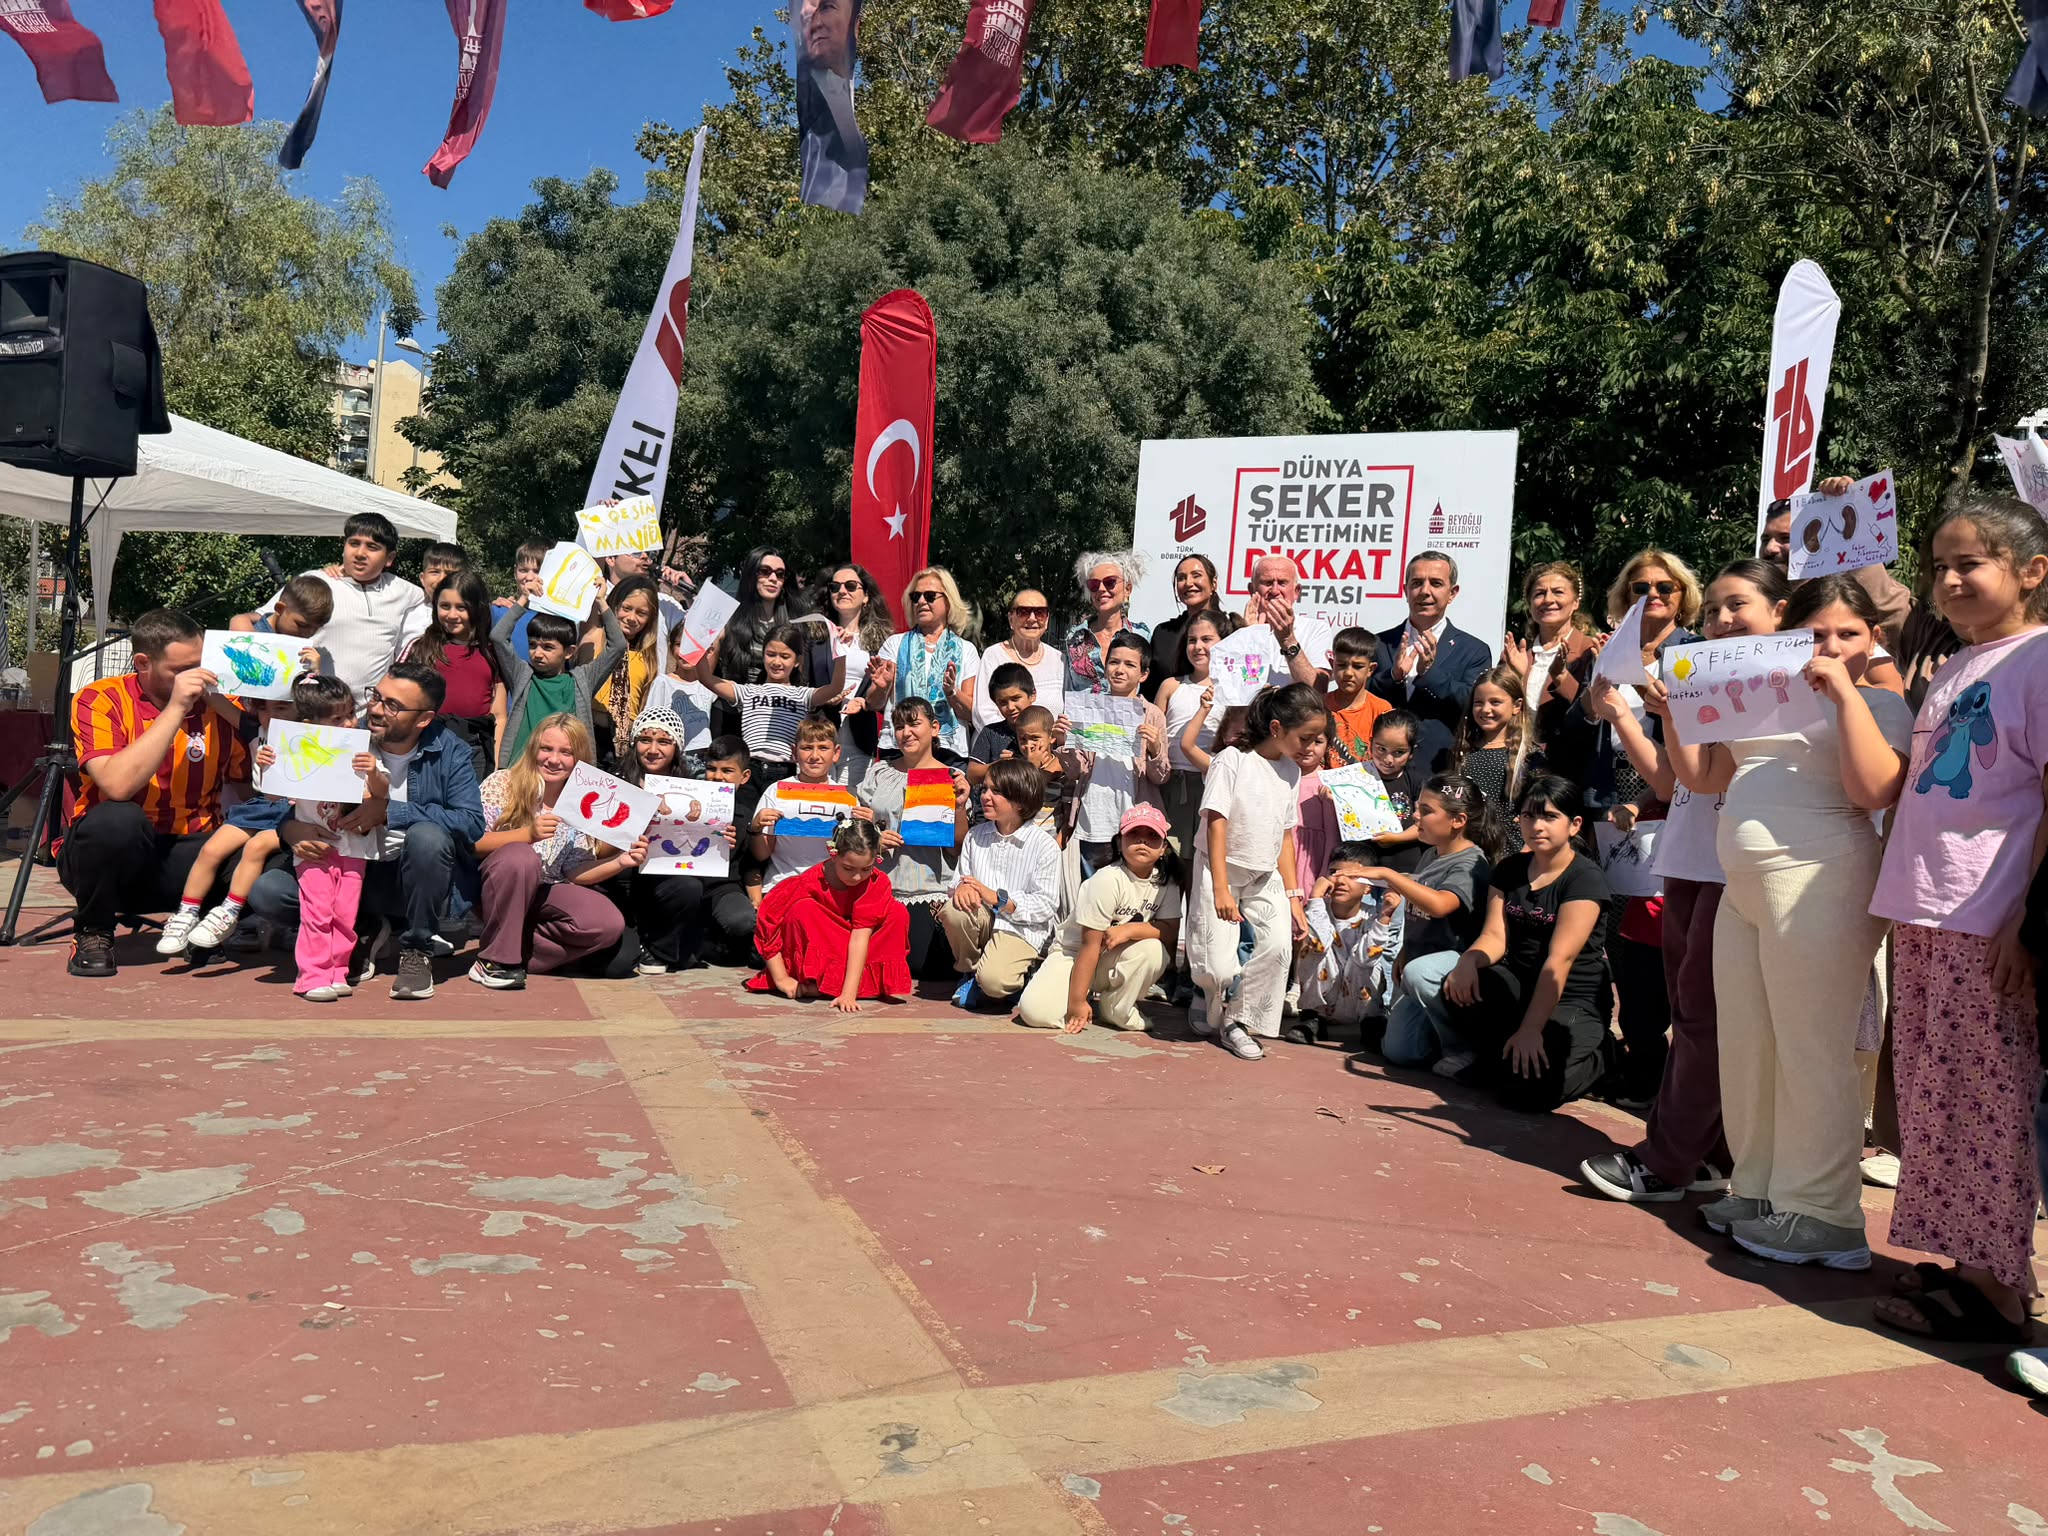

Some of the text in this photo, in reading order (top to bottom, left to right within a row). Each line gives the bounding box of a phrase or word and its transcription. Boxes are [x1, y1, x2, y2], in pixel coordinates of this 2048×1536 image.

[1282, 454, 1363, 479] DÜNYA
[1248, 483, 1395, 522] ŞEKER
[1448, 512, 1482, 526] BEYOĞLU
[1176, 545, 1194, 553] TÜRK
[1446, 541, 1481, 549] EMANET
[1295, 585, 1363, 605] FTASI
[752, 694, 797, 713] PARIS
